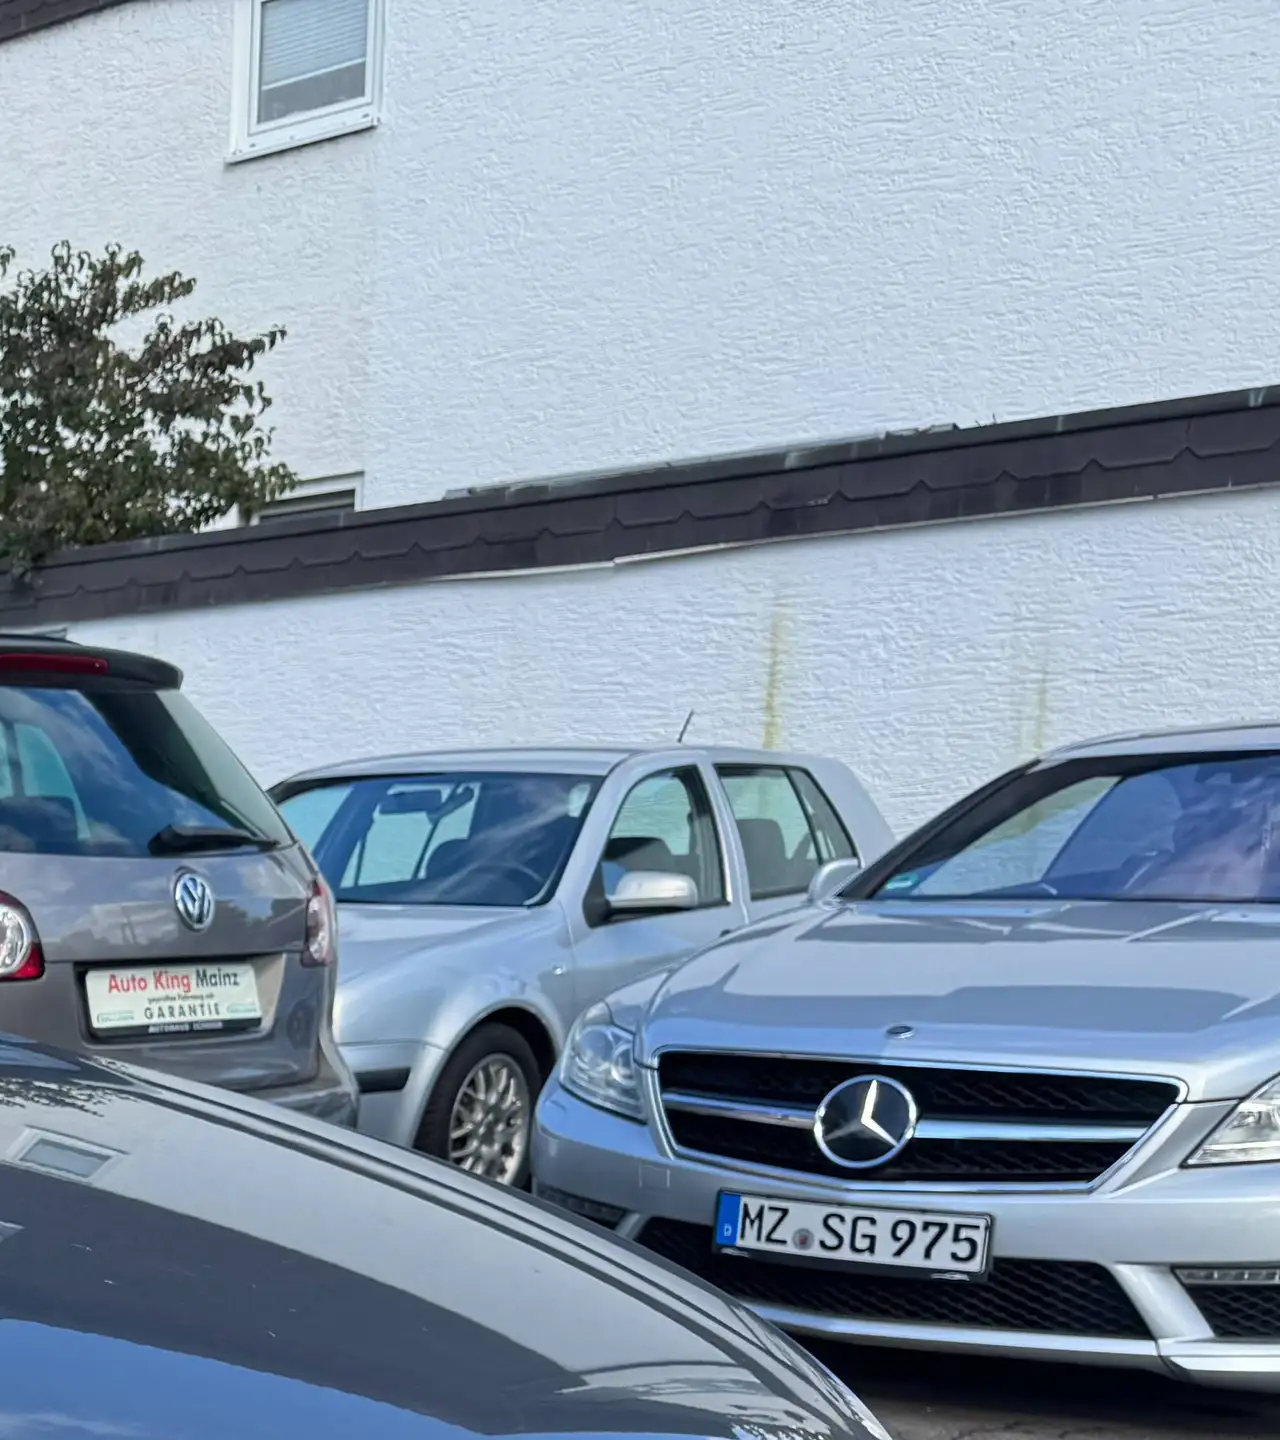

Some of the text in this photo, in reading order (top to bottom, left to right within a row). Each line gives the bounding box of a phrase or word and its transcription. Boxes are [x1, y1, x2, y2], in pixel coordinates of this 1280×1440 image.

[108, 968, 240, 994] Auto King Mainz
[144, 1003, 221, 1020] GARANTIE
[739, 1202, 790, 1245] MZ
[819, 1213, 877, 1256] SG
[891, 1219, 981, 1262] 975
